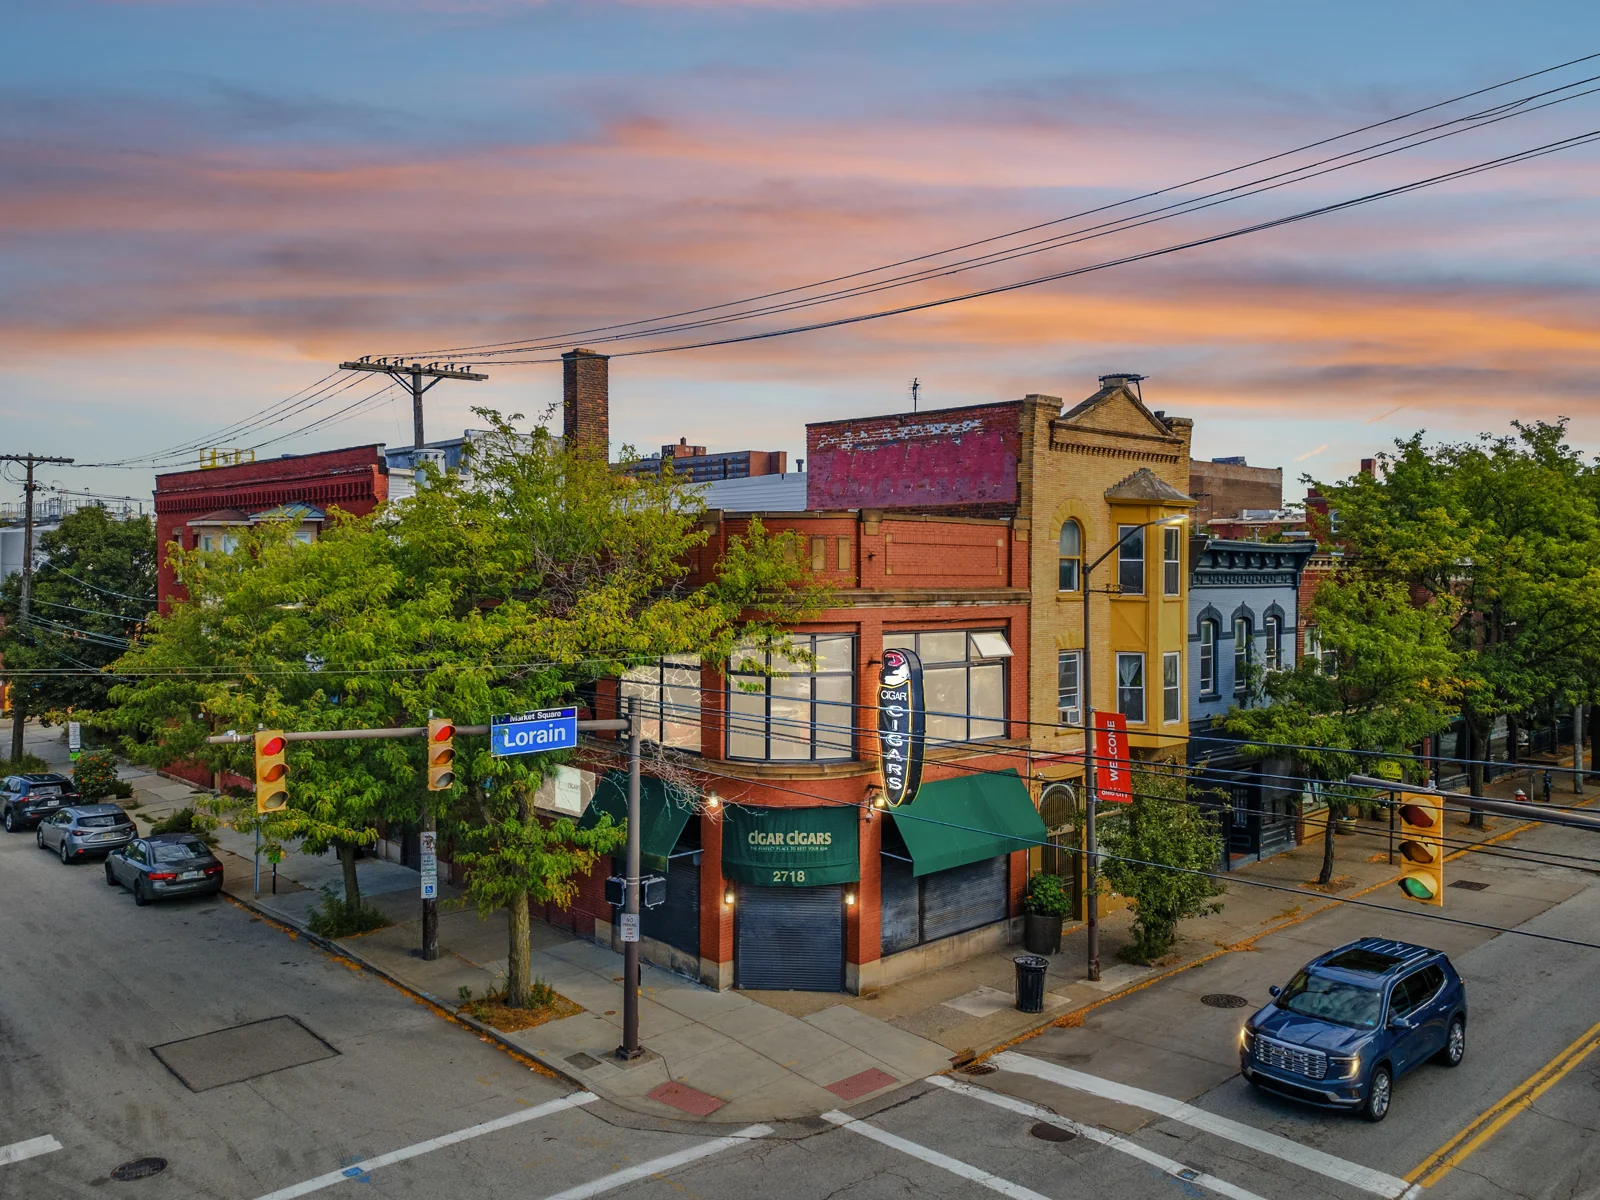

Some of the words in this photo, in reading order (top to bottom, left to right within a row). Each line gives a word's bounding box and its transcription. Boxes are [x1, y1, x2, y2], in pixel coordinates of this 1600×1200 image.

[880, 690, 907, 701] CIGAR
[509, 713, 535, 722] Market
[537, 711, 562, 720] Square
[504, 723, 566, 748] Lorain
[886, 705, 903, 790] CIGARS
[773, 871, 805, 882] 2718
